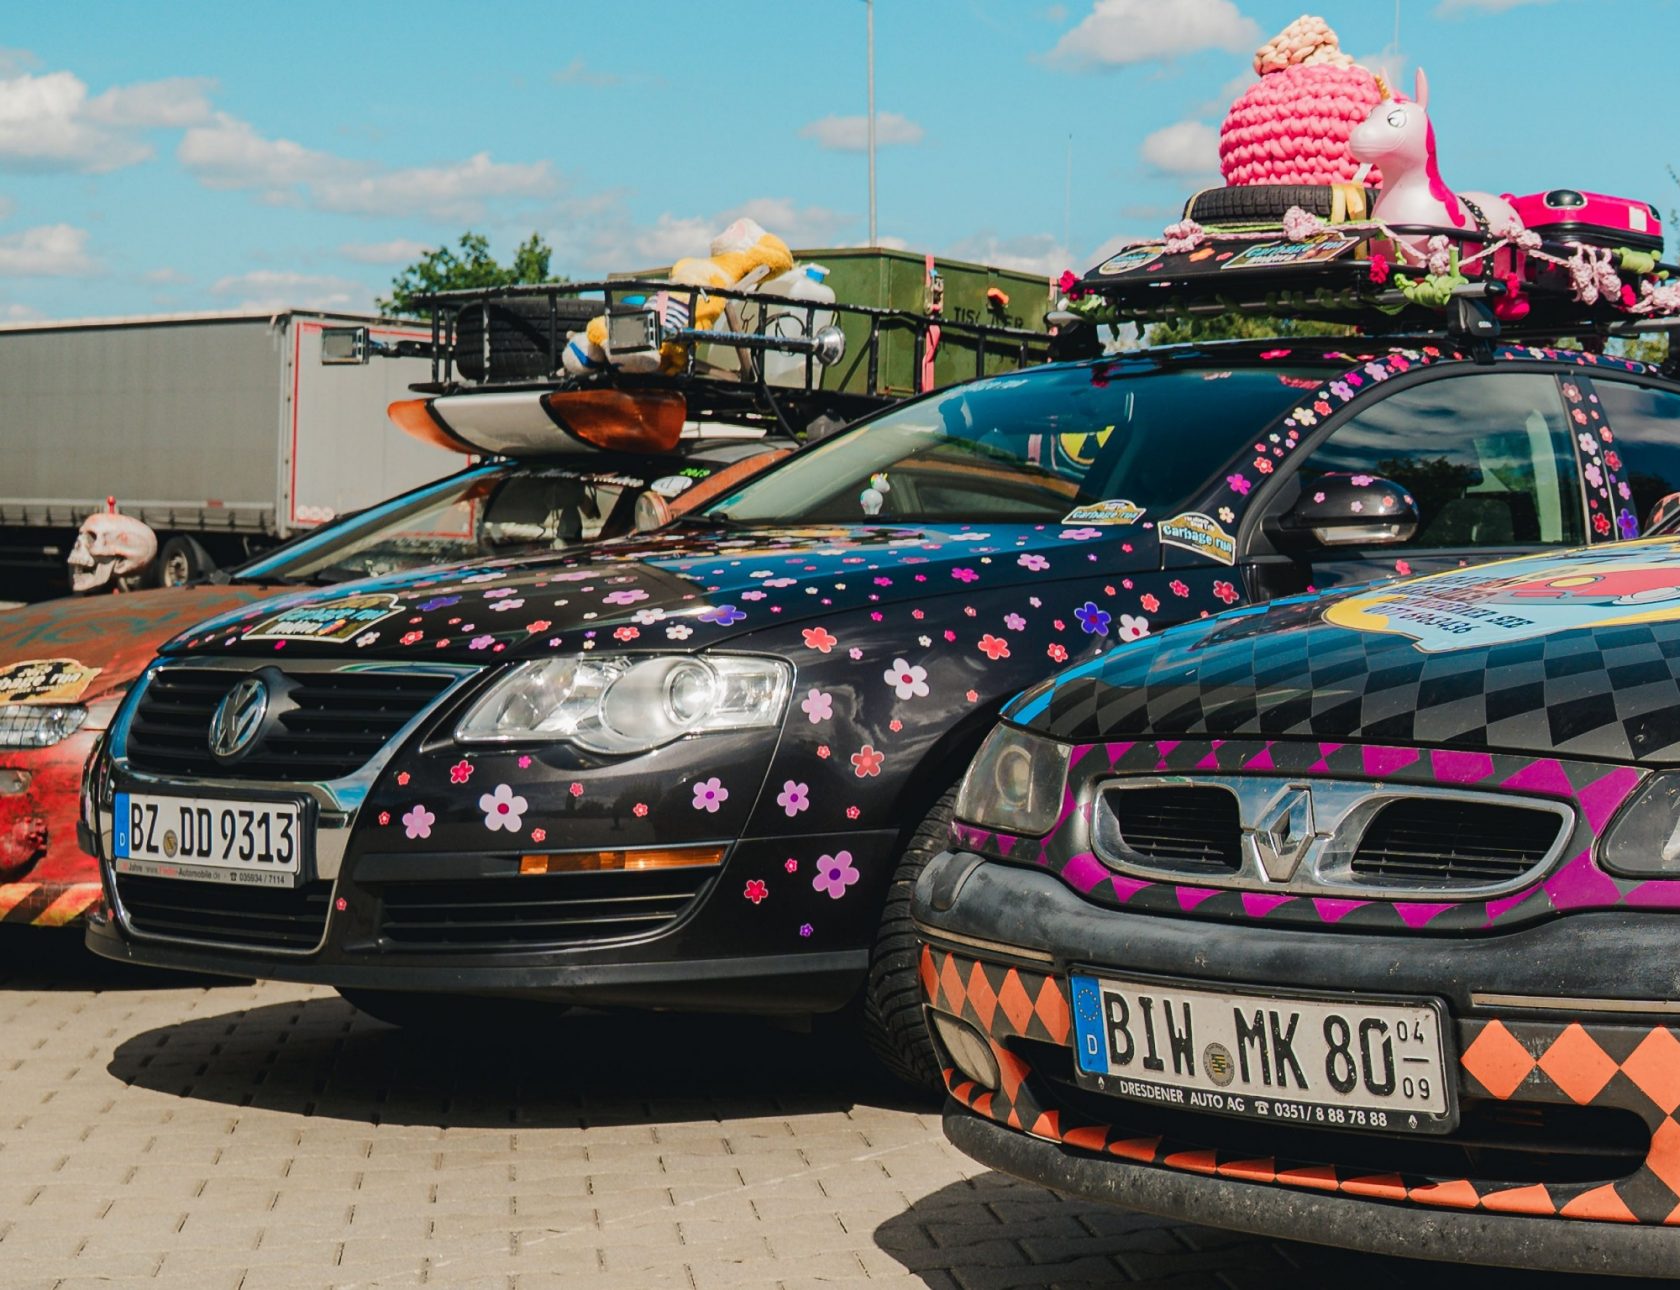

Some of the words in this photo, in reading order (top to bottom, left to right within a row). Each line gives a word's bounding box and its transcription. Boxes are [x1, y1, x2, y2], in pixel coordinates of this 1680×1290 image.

[1162, 525, 1213, 545] Carbage
[119, 832, 126, 847] D
[131, 803, 159, 854] BZ
[180, 806, 213, 858] DD
[221, 809, 294, 864] 9313
[1087, 1034, 1098, 1055] D
[1103, 991, 1196, 1077] BIW
[1234, 1007, 1309, 1089] MK
[1323, 1014, 1397, 1097] 80
[1397, 1020, 1425, 1044] 04
[1120, 1080, 1184, 1105] DRESDENER
[1190, 1092, 1224, 1110] AUTO
[1226, 1096, 1245, 1112] AG
[1316, 1107, 1325, 1122] 8
[1328, 1108, 1345, 1124] 88
[1348, 1110, 1366, 1126] 78
[1370, 1112, 1388, 1128] 88
[1403, 1076, 1431, 1100] 09
